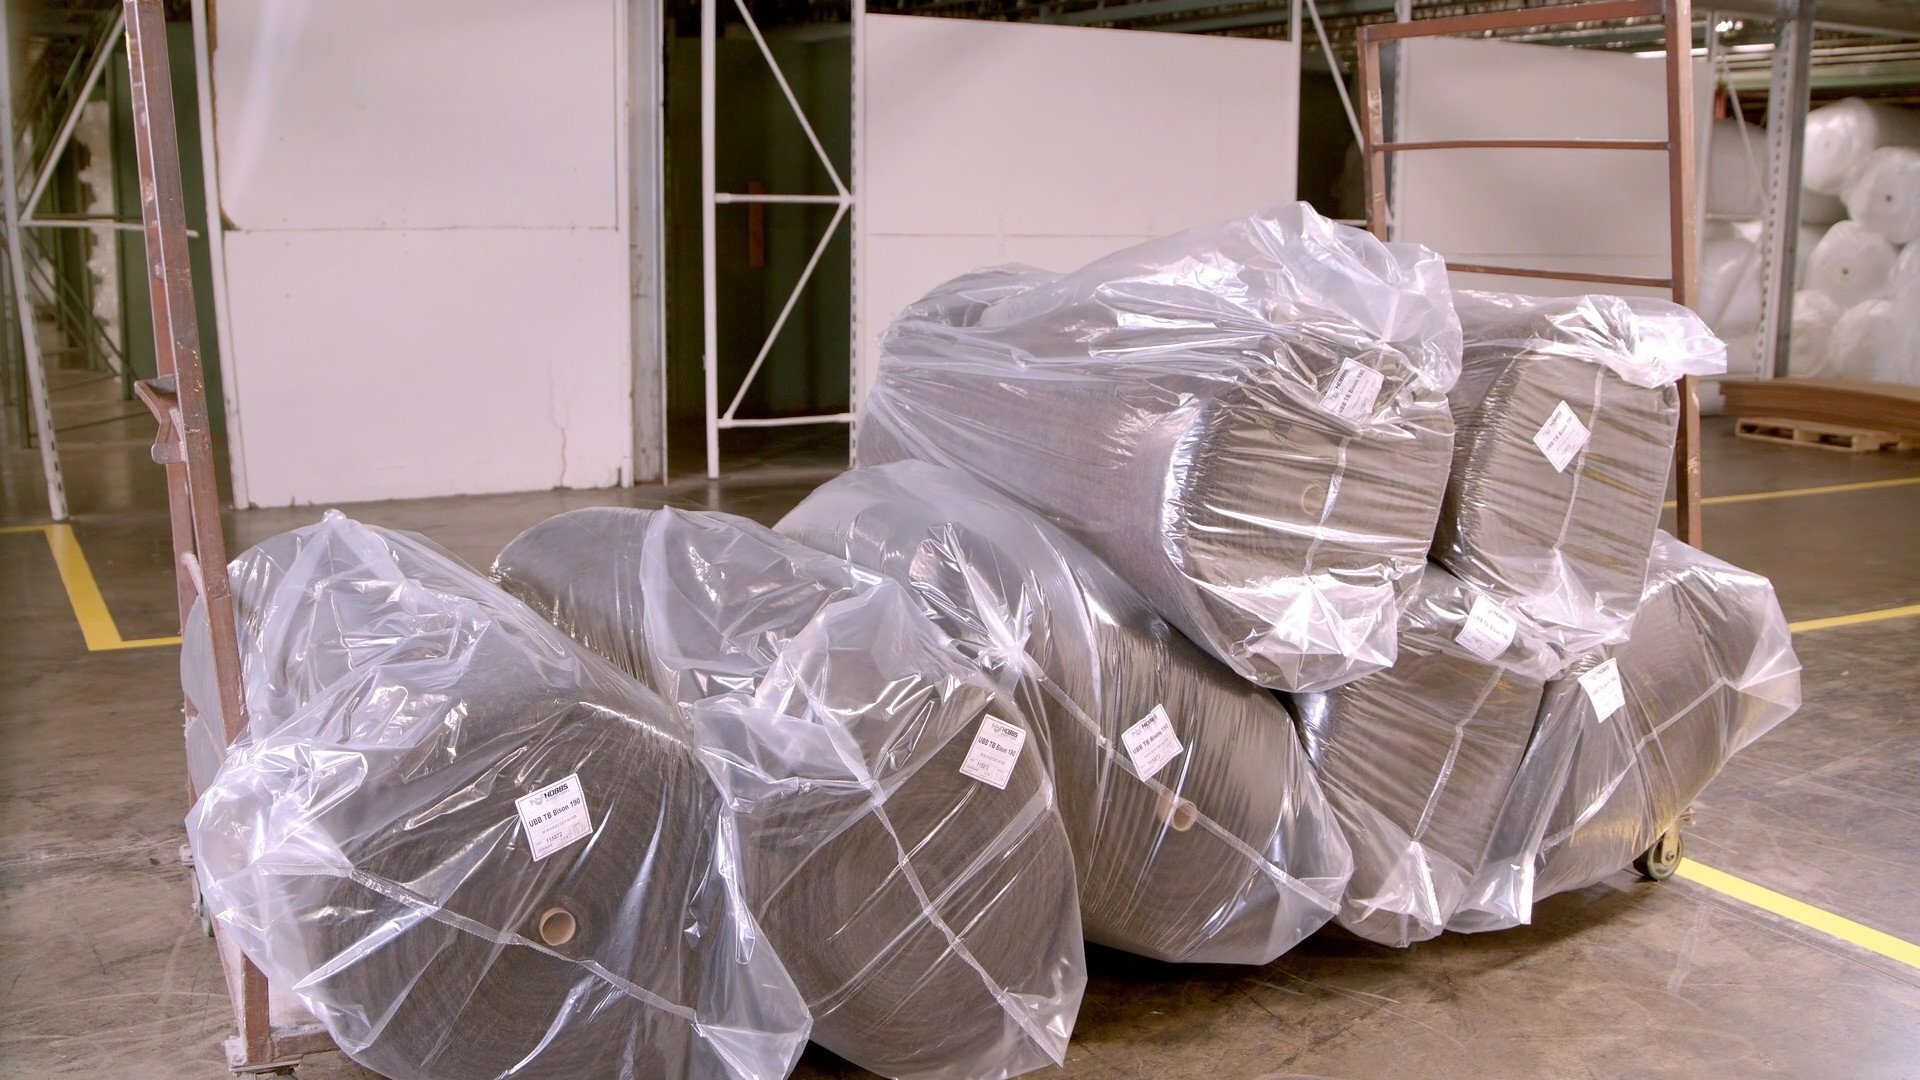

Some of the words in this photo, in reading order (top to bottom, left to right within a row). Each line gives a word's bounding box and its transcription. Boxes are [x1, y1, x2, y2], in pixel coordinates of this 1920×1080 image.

[544, 783, 568, 799] HOBBS
[528, 817, 542, 828] UBB
[543, 812, 552, 821] TB
[553, 804, 569, 816] Bison
[570, 797, 581, 807] 190
